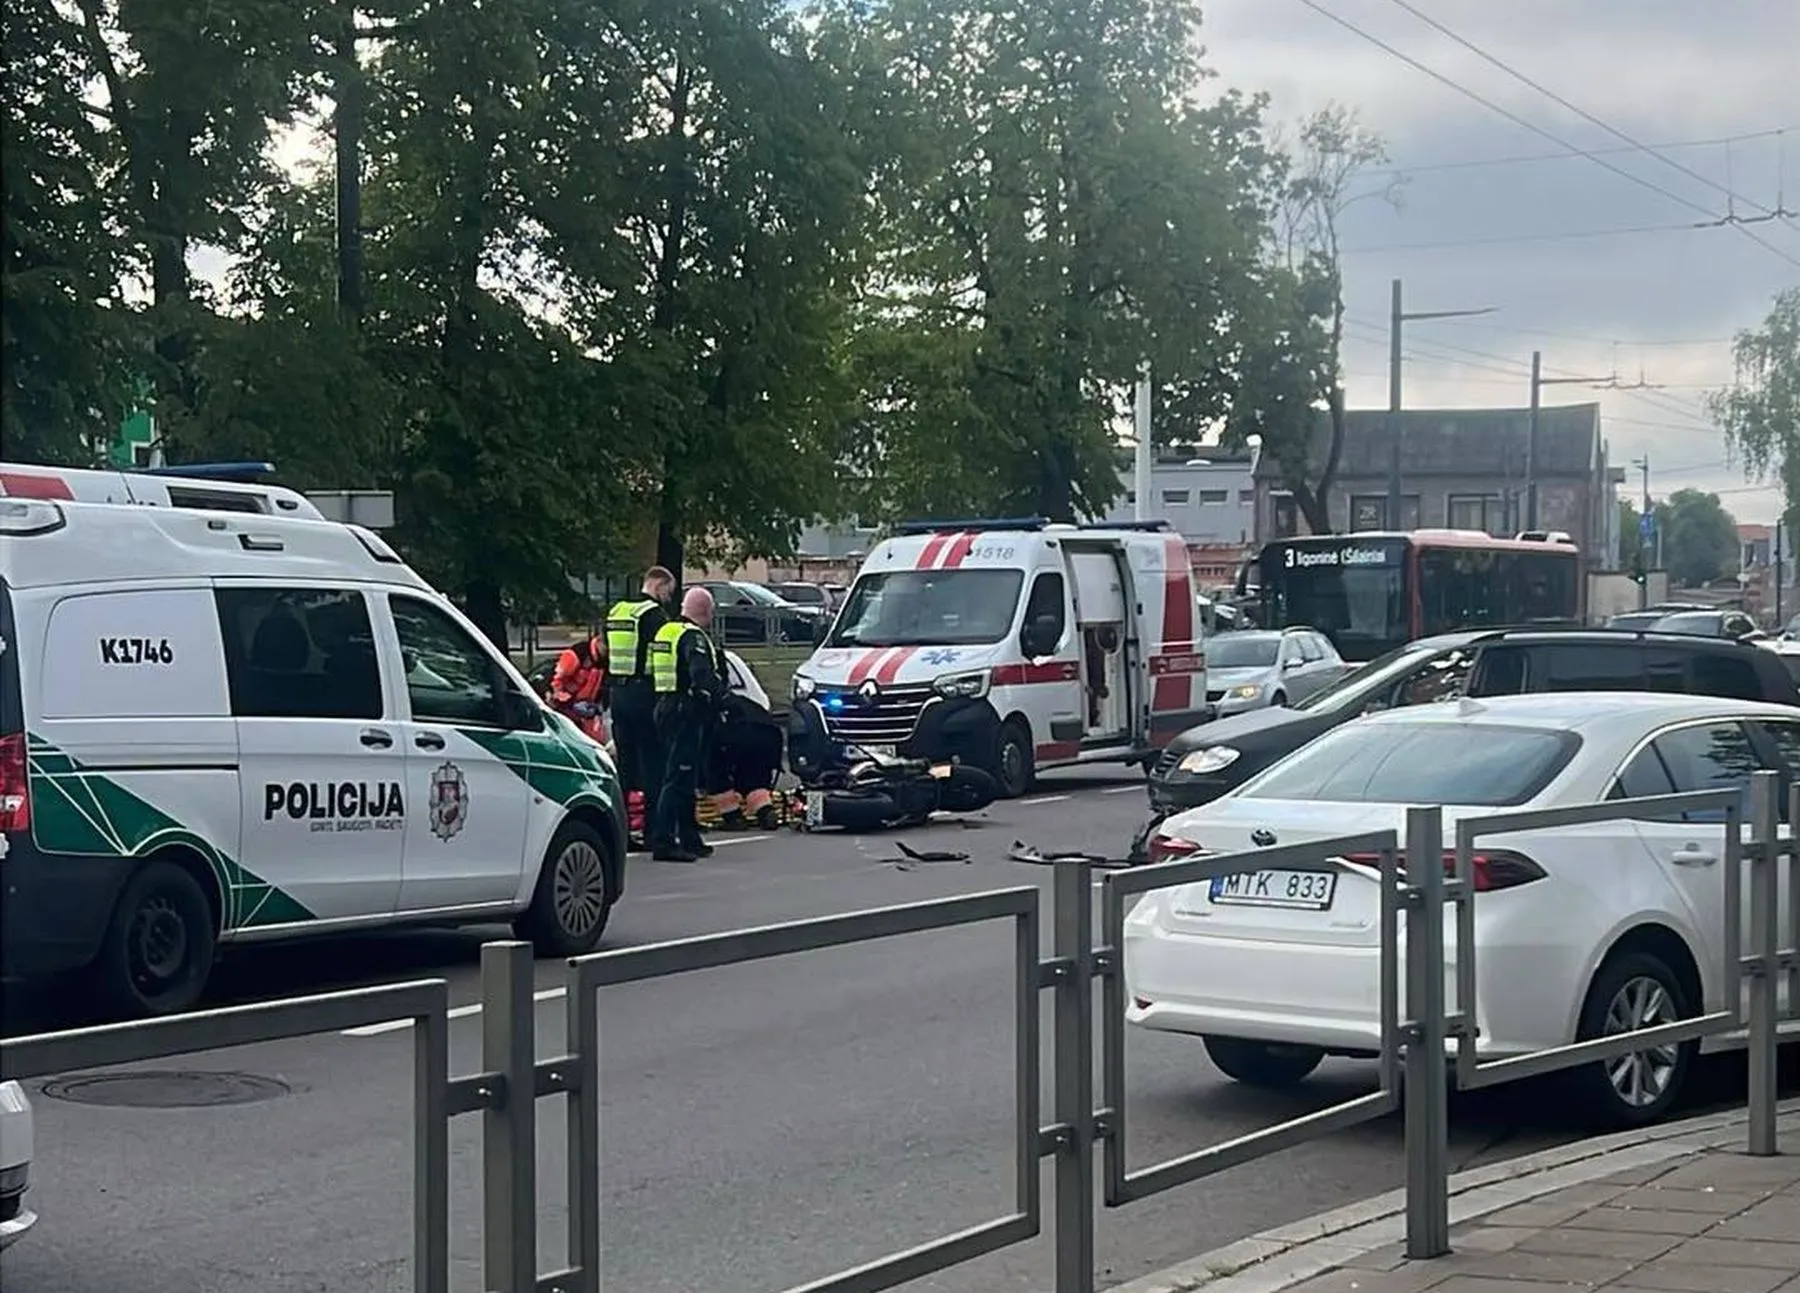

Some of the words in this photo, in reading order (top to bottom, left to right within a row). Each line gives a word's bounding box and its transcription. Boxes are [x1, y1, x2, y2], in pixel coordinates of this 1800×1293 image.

[1285, 548, 1294, 567] 3
[100, 638, 173, 664] K1746
[265, 782, 404, 820] POLICIJA
[1224, 873, 1273, 896] MTK
[1286, 875, 1328, 899] 833
